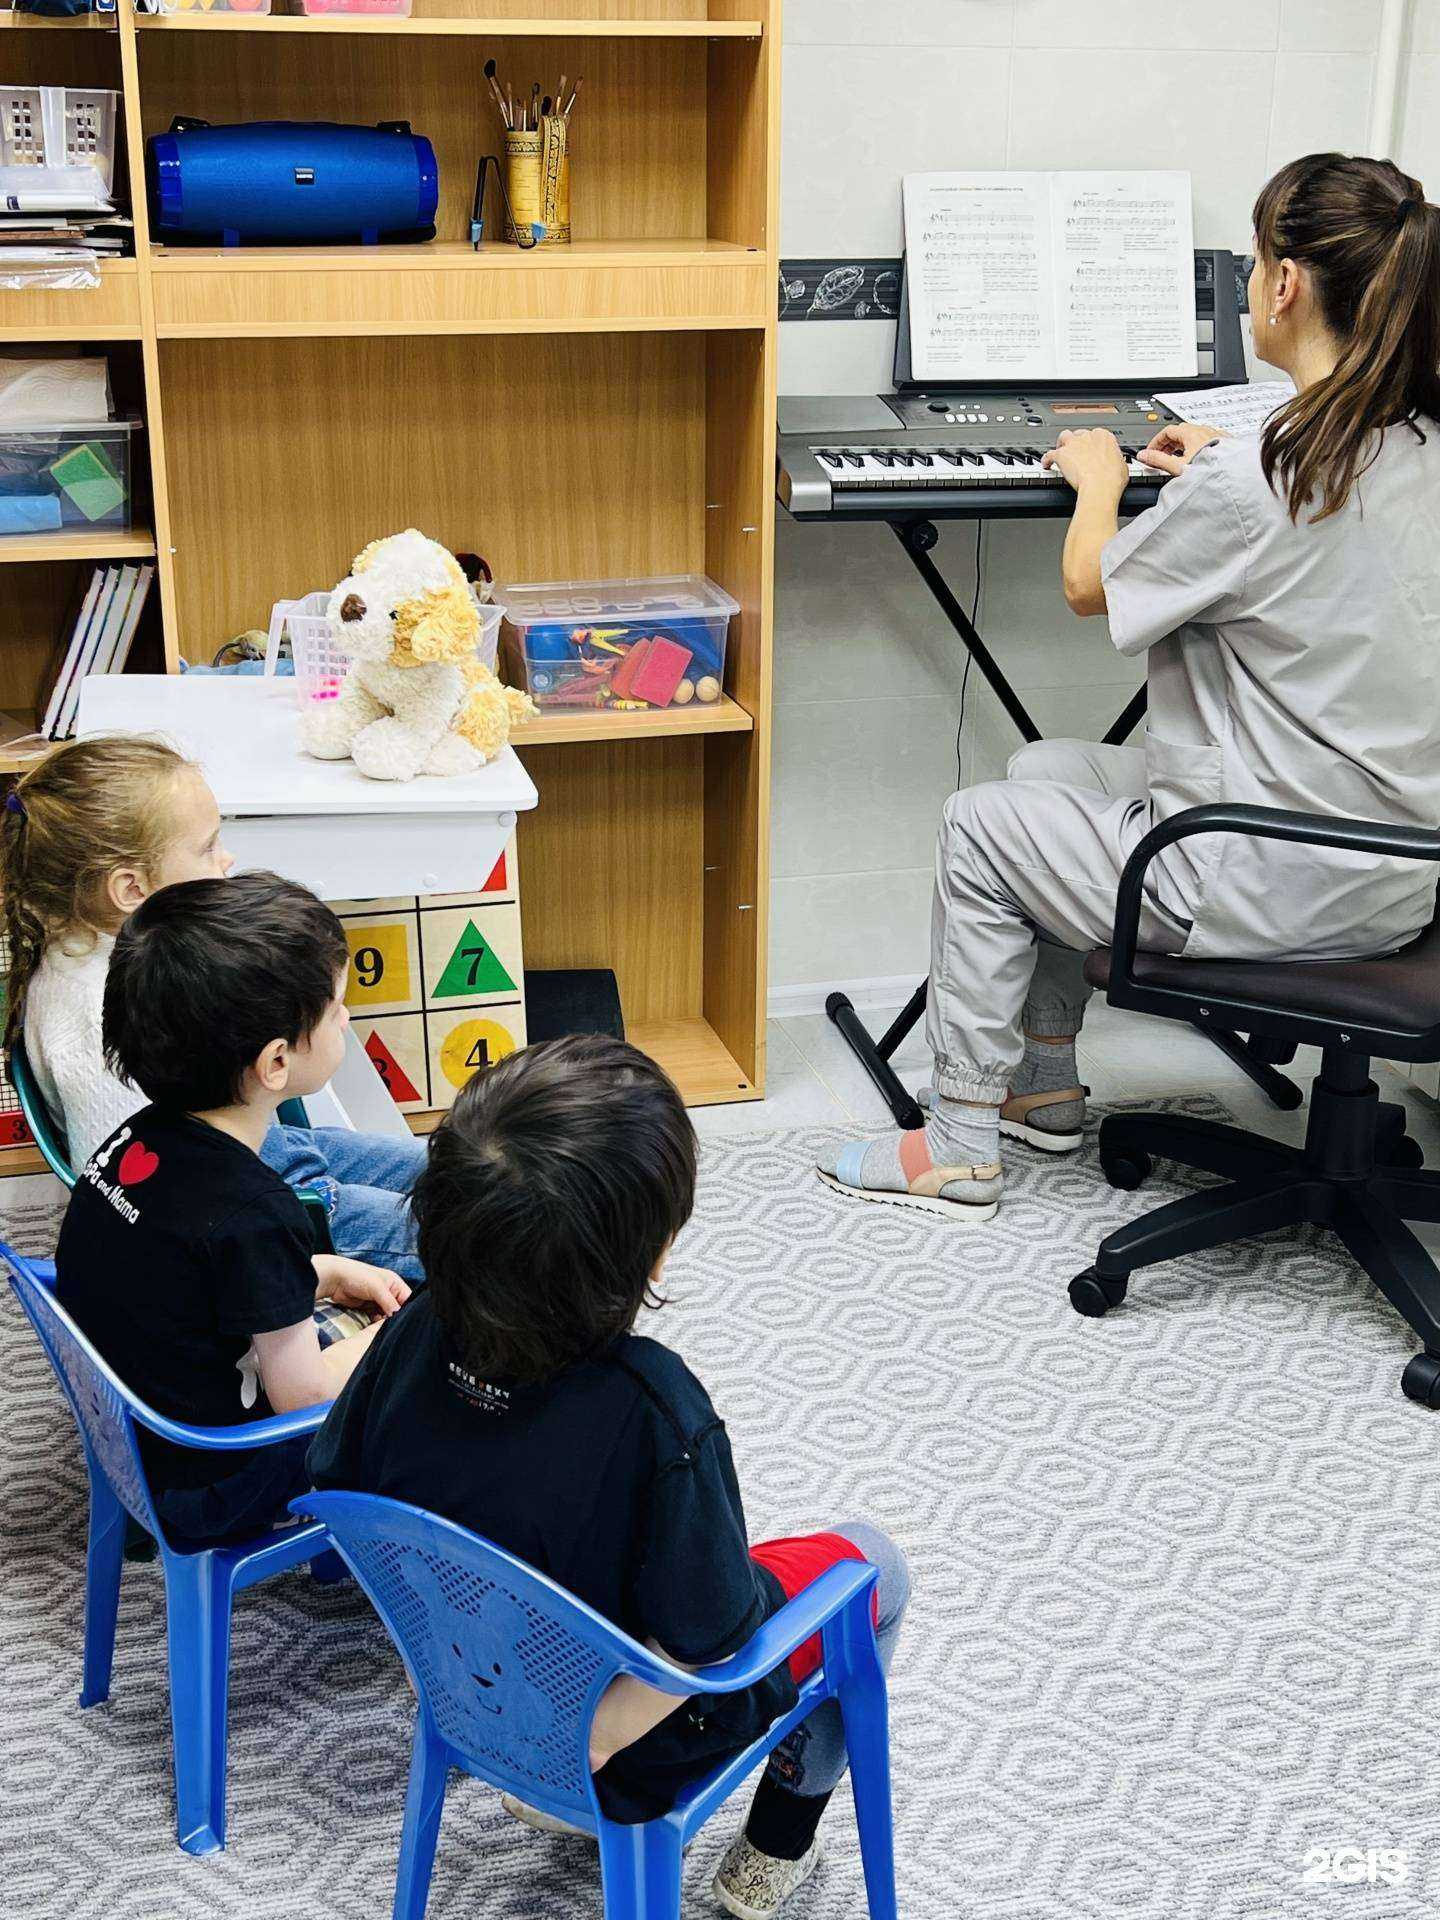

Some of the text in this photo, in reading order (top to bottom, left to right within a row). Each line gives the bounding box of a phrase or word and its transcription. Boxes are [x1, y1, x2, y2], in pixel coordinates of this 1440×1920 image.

[354, 947, 384, 987] 9
[460, 947, 485, 986] 7
[465, 1038, 494, 1071] 4
[12, 1119, 28, 1141] 3
[96, 1179, 114, 1198] and
[107, 1185, 140, 1225] Mama
